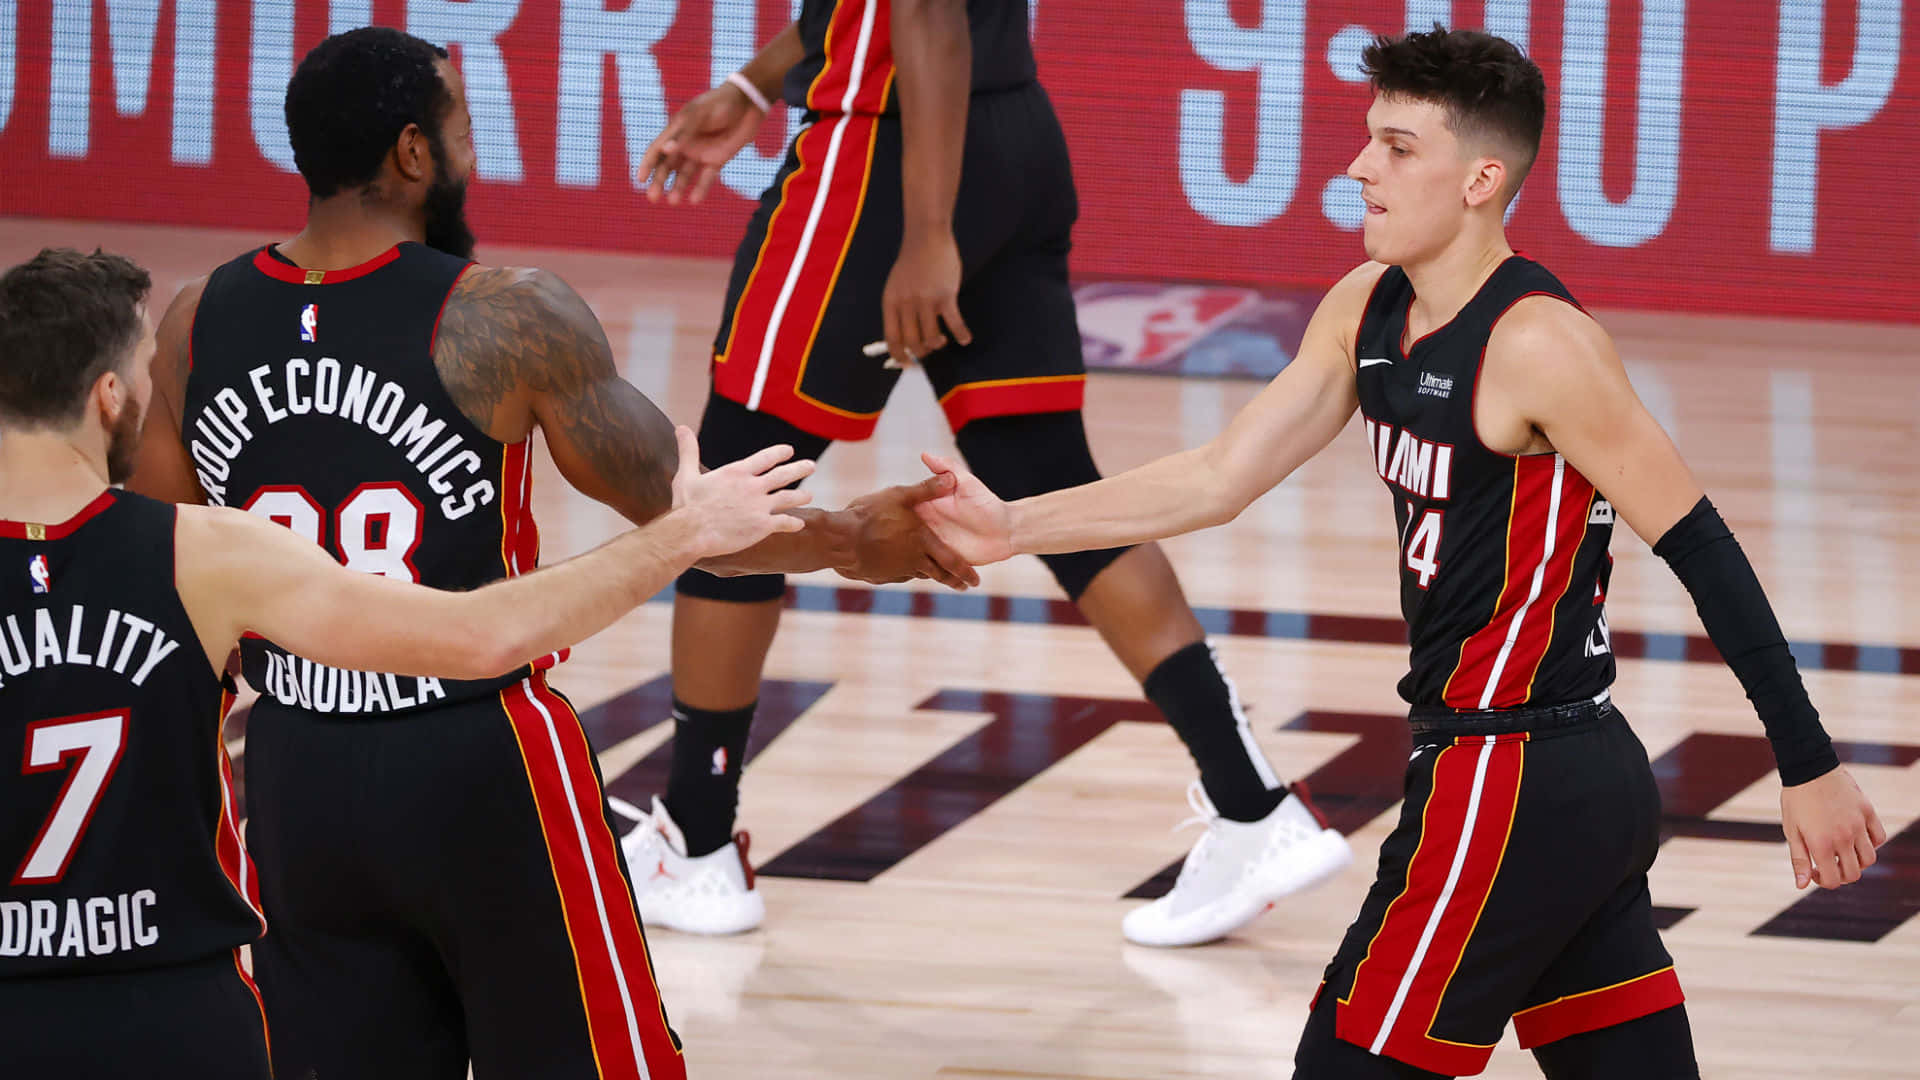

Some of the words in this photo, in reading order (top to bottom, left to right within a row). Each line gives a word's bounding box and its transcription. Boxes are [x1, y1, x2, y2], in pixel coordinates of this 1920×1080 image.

[191, 387, 253, 507] ROUP
[249, 357, 495, 520] ECONOMICS
[1400, 499, 1445, 591] 4
[0, 604, 180, 688] UALITY
[10, 707, 132, 886] 7
[0, 889, 160, 957] DRAGIC
